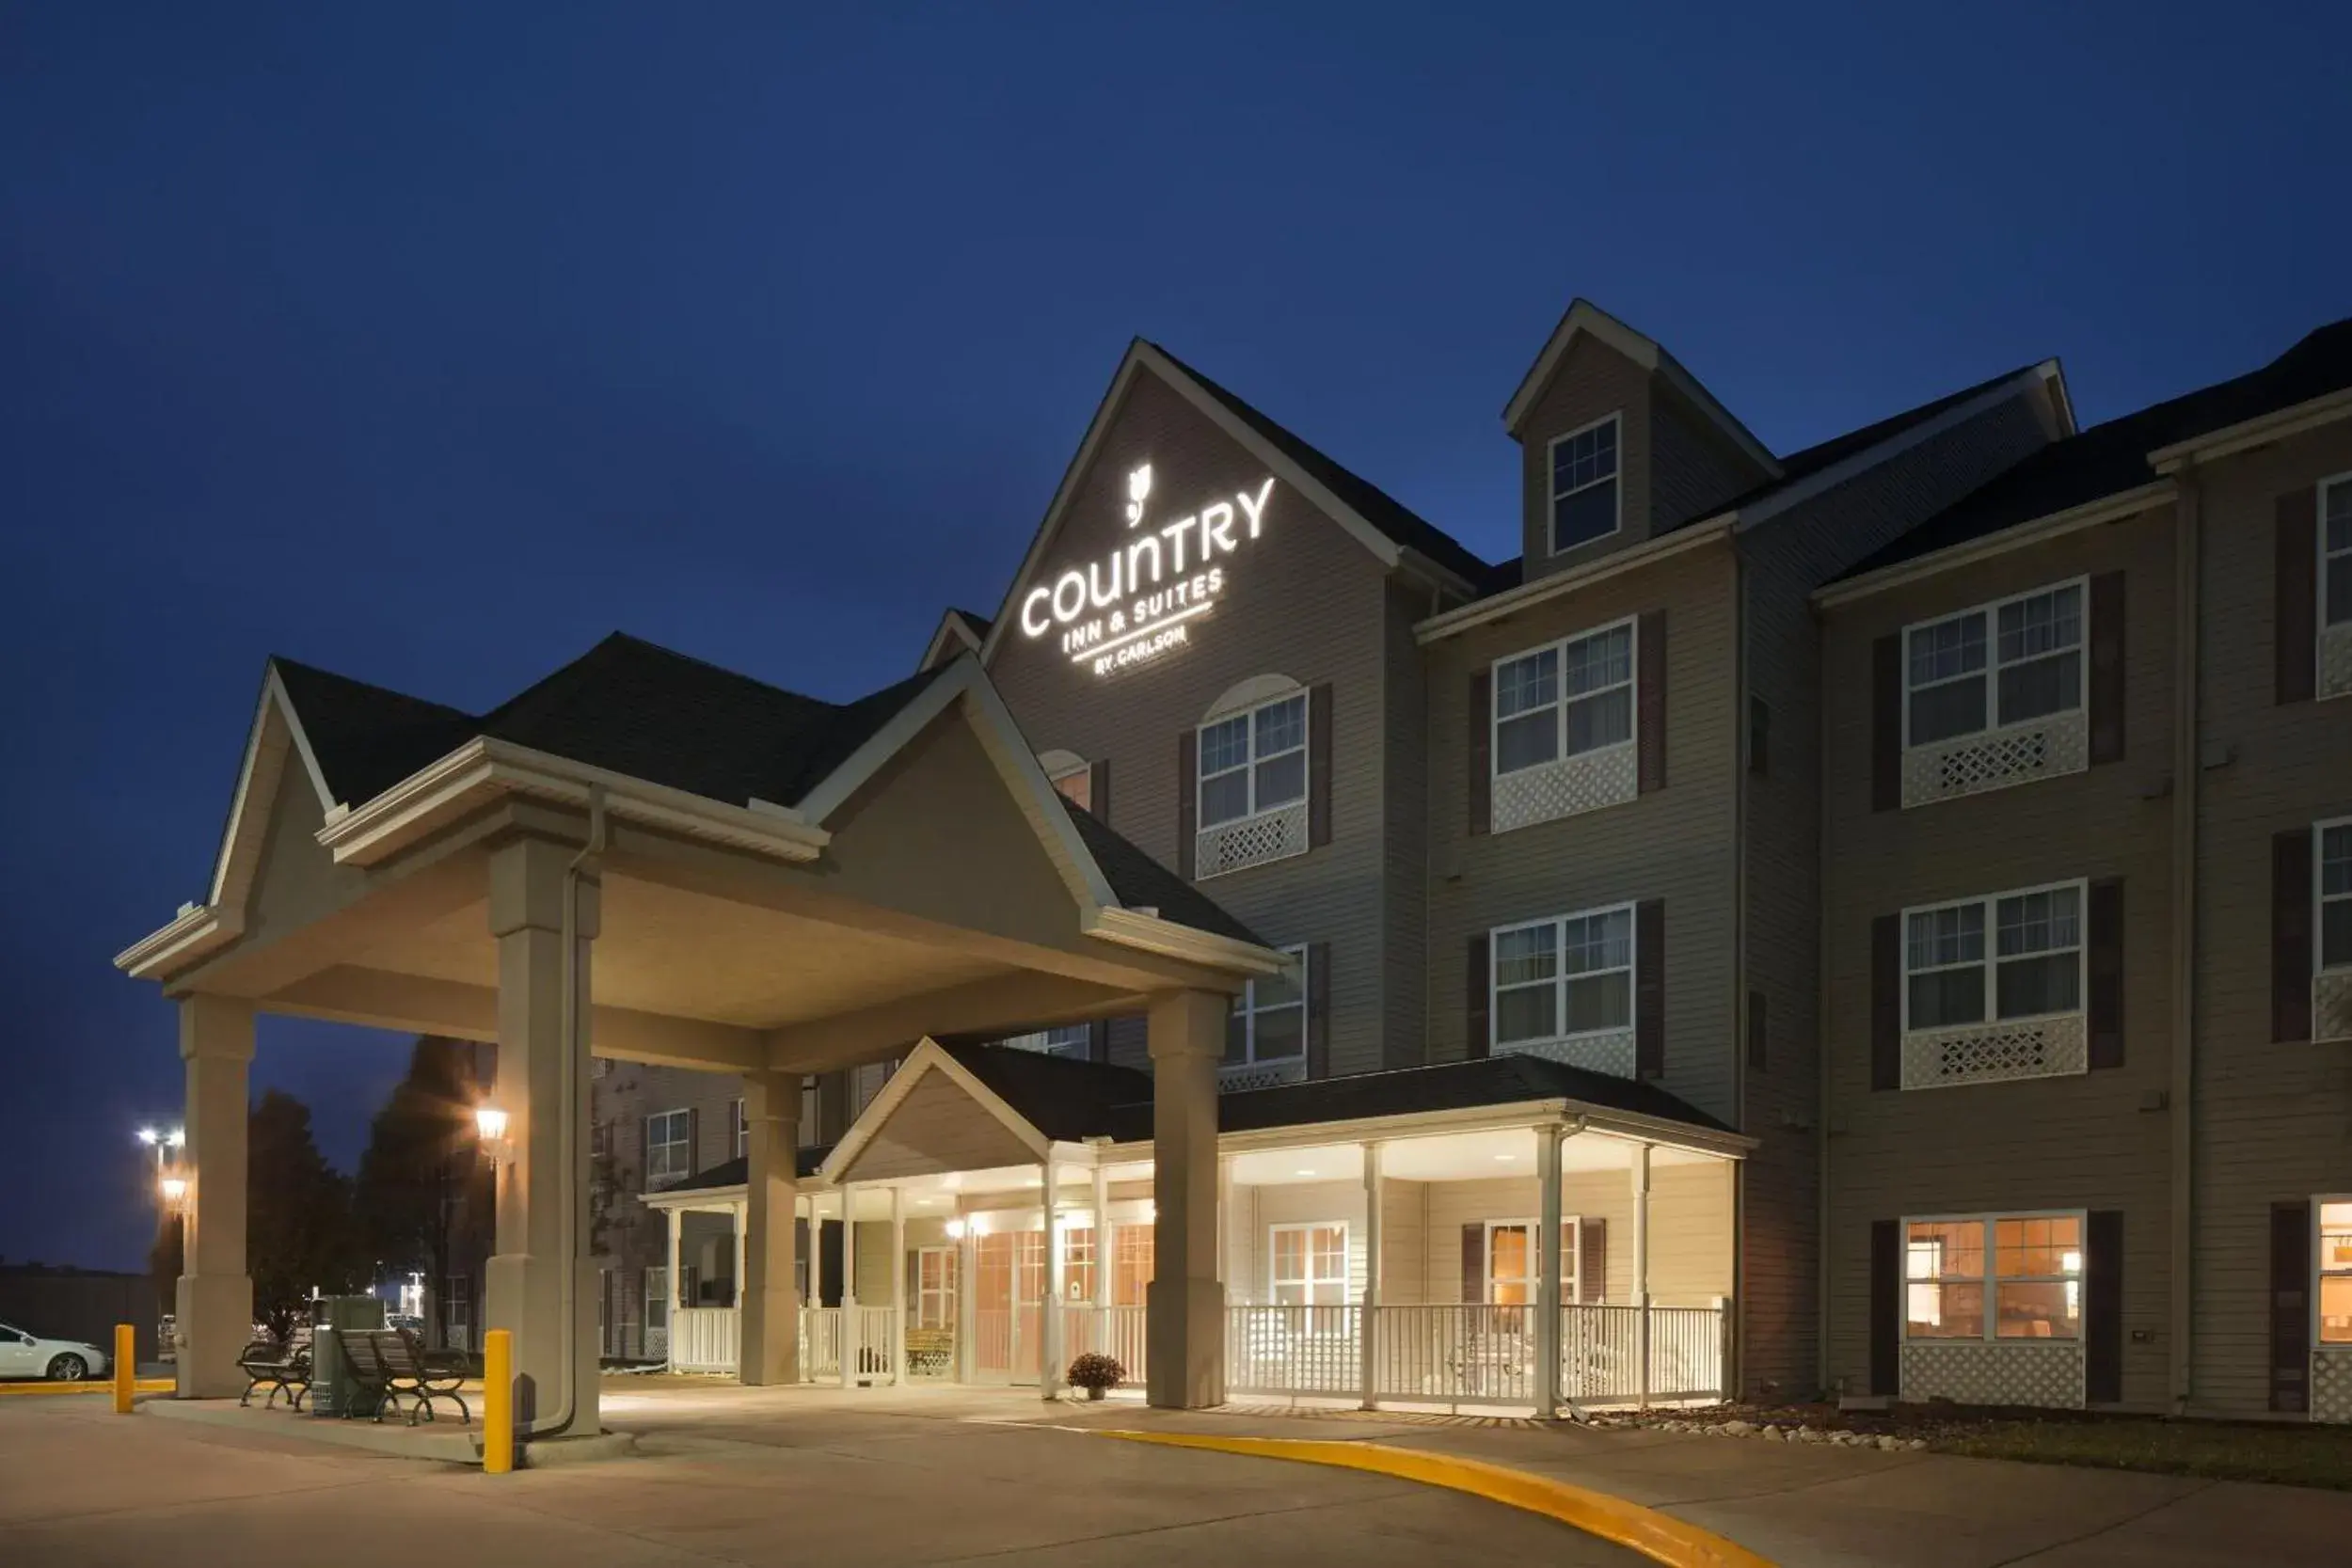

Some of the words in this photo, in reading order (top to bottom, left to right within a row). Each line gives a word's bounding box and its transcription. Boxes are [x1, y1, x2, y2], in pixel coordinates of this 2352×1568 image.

[1062, 619, 1102, 653] INN
[1109, 610, 1126, 633] &
[1134, 567, 1223, 623] SUITES
[1094, 656, 1113, 674] BY
[1118, 625, 1187, 666] CARLSON
